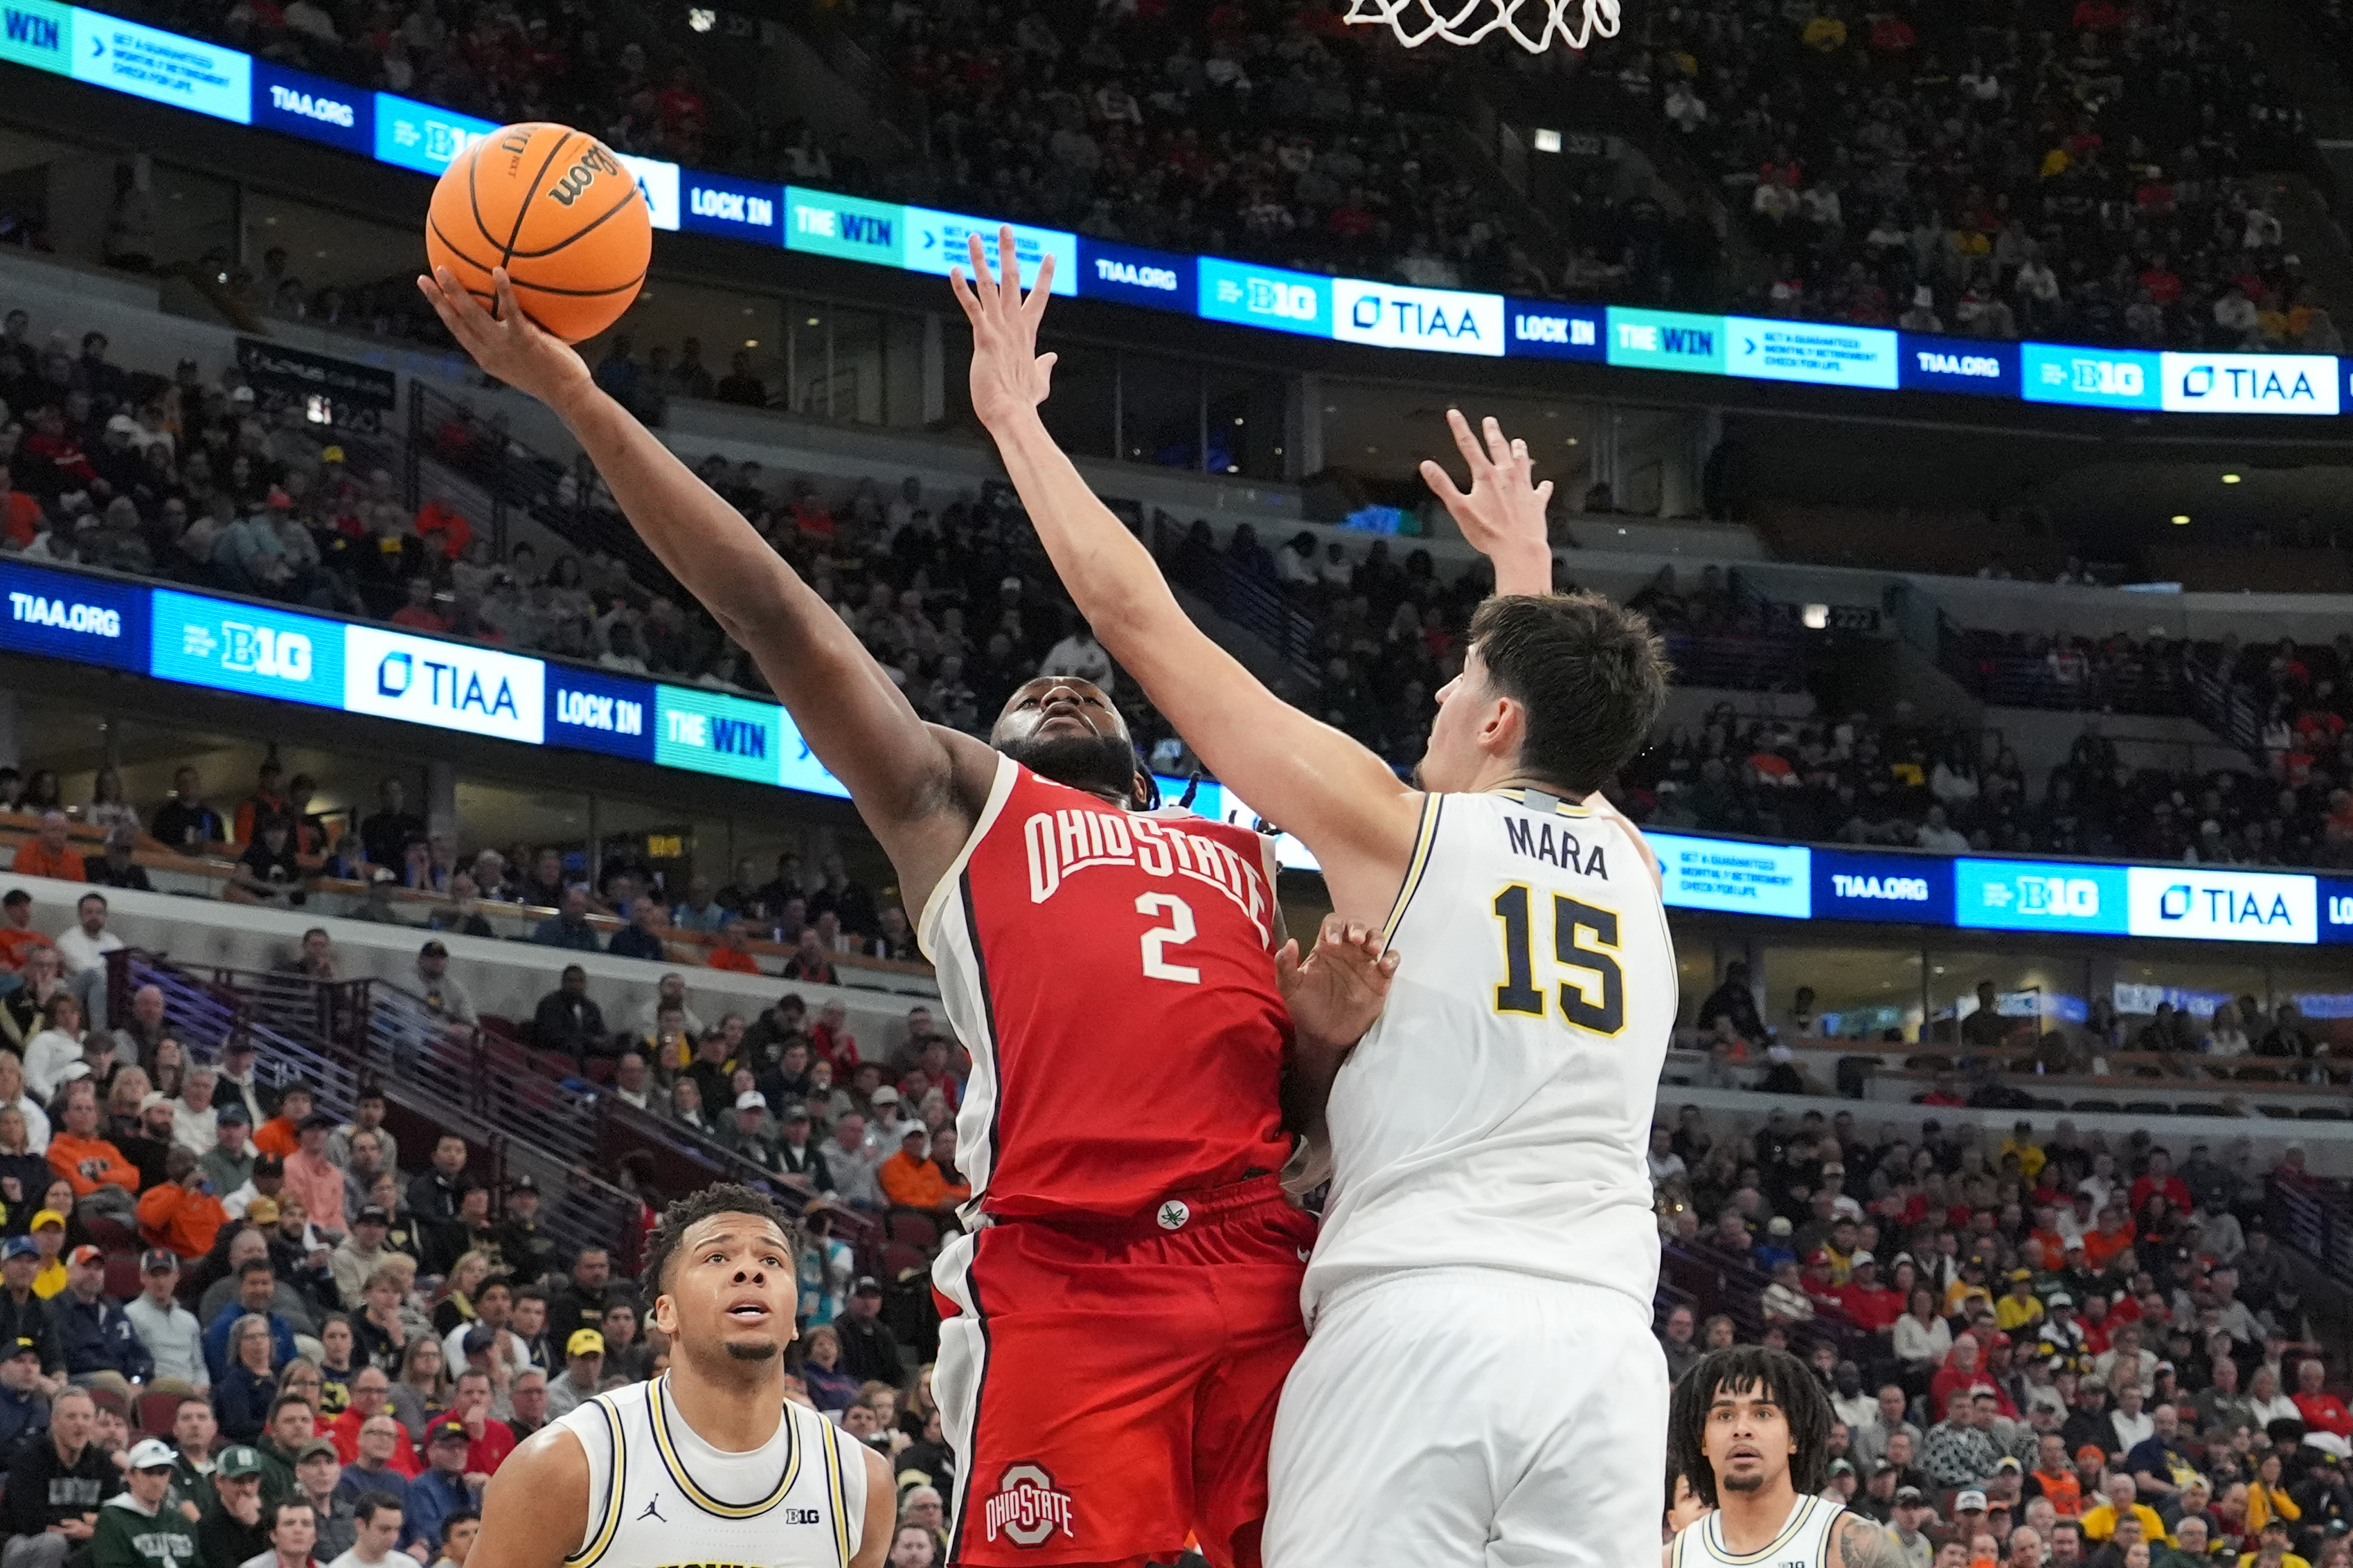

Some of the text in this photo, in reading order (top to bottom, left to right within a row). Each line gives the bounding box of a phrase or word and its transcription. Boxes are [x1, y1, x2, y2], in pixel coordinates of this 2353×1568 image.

[5, 8, 59, 51] WIN
[269, 84, 355, 127] TIAA.ORG
[691, 187, 745, 222] LOCK
[746, 197, 773, 226] IN
[795, 205, 892, 246] THE WIN
[1095, 258, 1177, 291] TIAA.ORG
[1391, 301, 1480, 339] TIAA
[1515, 314, 1595, 345] LOCK IN
[1616, 323, 1713, 357] THE WIN
[1917, 352, 2000, 377] TIAA.ORG
[2226, 369, 2315, 399] TIAA
[9, 591, 120, 638] TIAA.ORG
[423, 660, 519, 719] TIAA
[557, 689, 642, 735] LOCK IN
[665, 710, 765, 759] THE WIN
[1504, 816, 1609, 881] MARA
[1832, 874, 1928, 901] TIAA.ORG
[2202, 889, 2292, 926] TIAA
[2329, 896, 2353, 924] LO
[1134, 891, 1201, 984] 2
[1492, 881, 1627, 1038] 15
